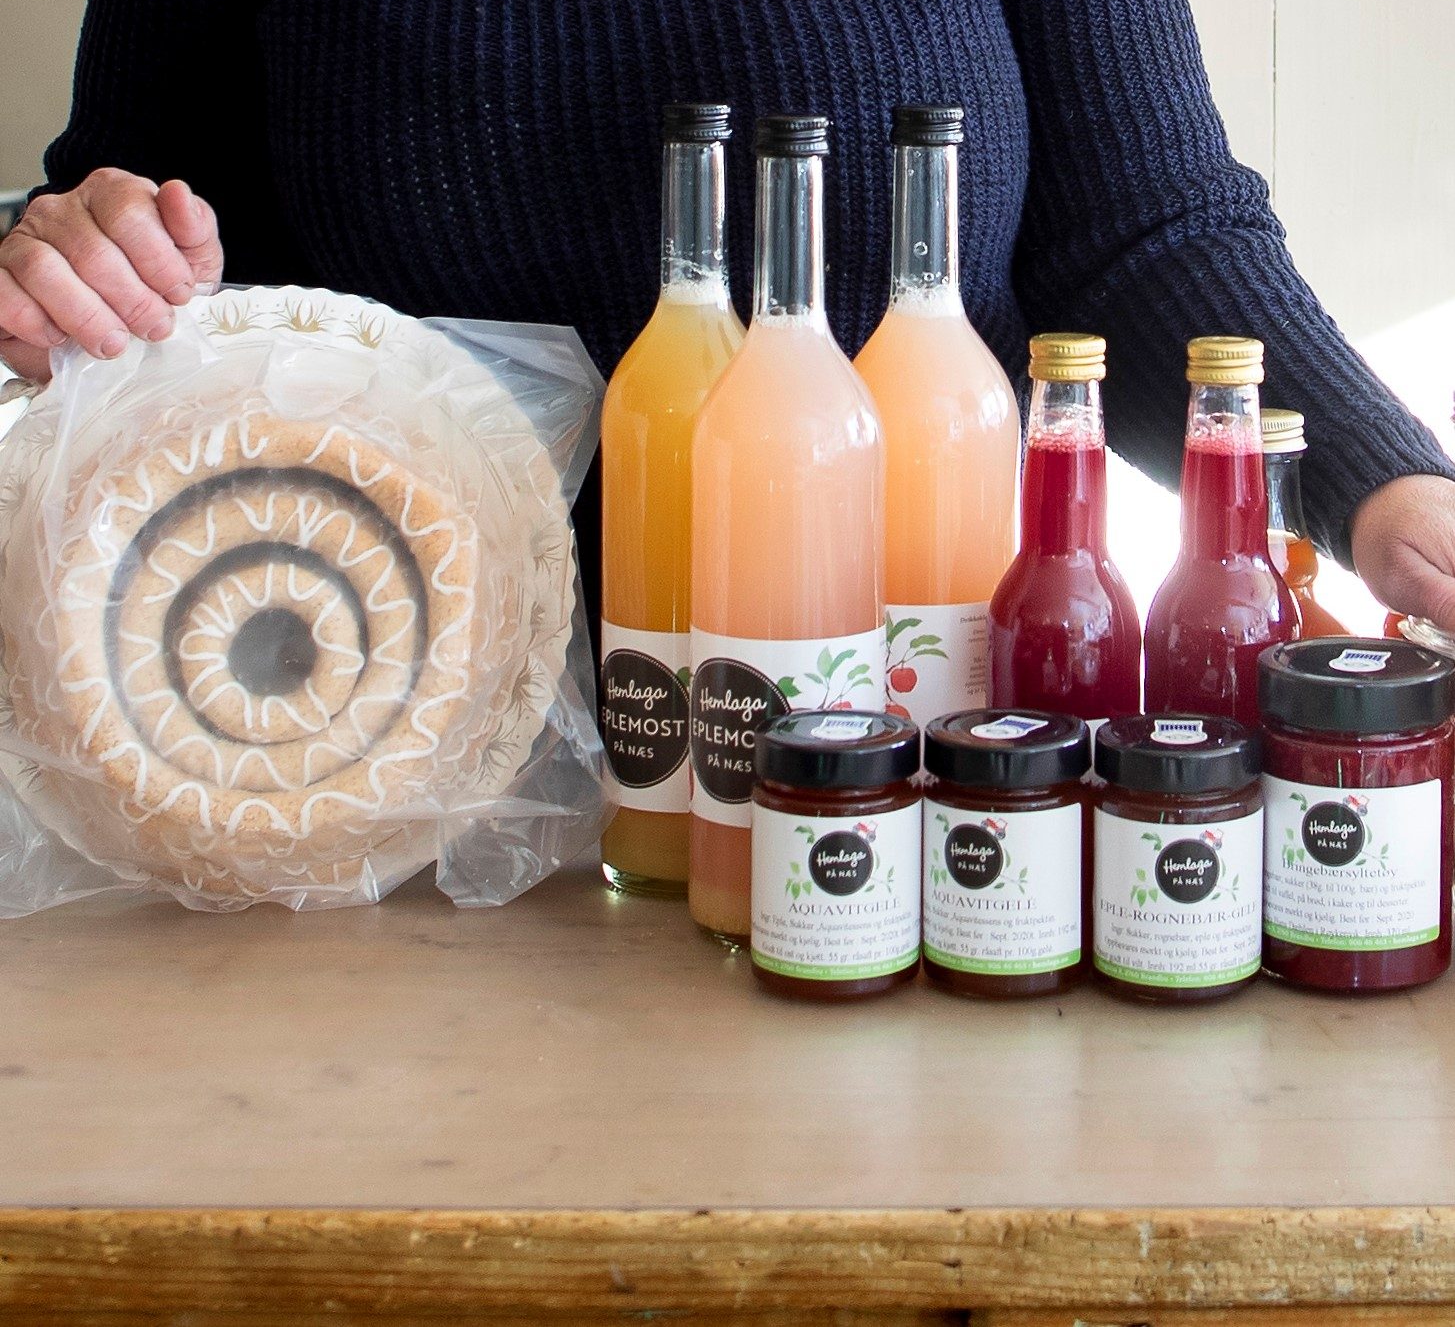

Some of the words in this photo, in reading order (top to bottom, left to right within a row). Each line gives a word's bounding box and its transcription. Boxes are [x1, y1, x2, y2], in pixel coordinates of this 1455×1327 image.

[606, 676, 668, 711] Hemlaga
[700, 687, 768, 722] Hemlaga
[602, 706, 685, 737] EPLEMOST
[692, 718, 755, 749] EPLEMO
[613, 740, 626, 753] PÅ
[628, 745, 655, 759] NÆS
[707, 753, 720, 768] PÅ
[724, 758, 752, 772] NÆS
[1309, 820, 1357, 840] Hemlaga
[950, 842, 996, 862] Hemlaga
[1317, 838, 1328, 847] PÅ
[816, 849, 867, 868] Hemlaga
[1163, 857, 1213, 876] Hemlaga
[826, 869, 837, 878] PÅ
[1172, 875, 1183, 885] PÅ
